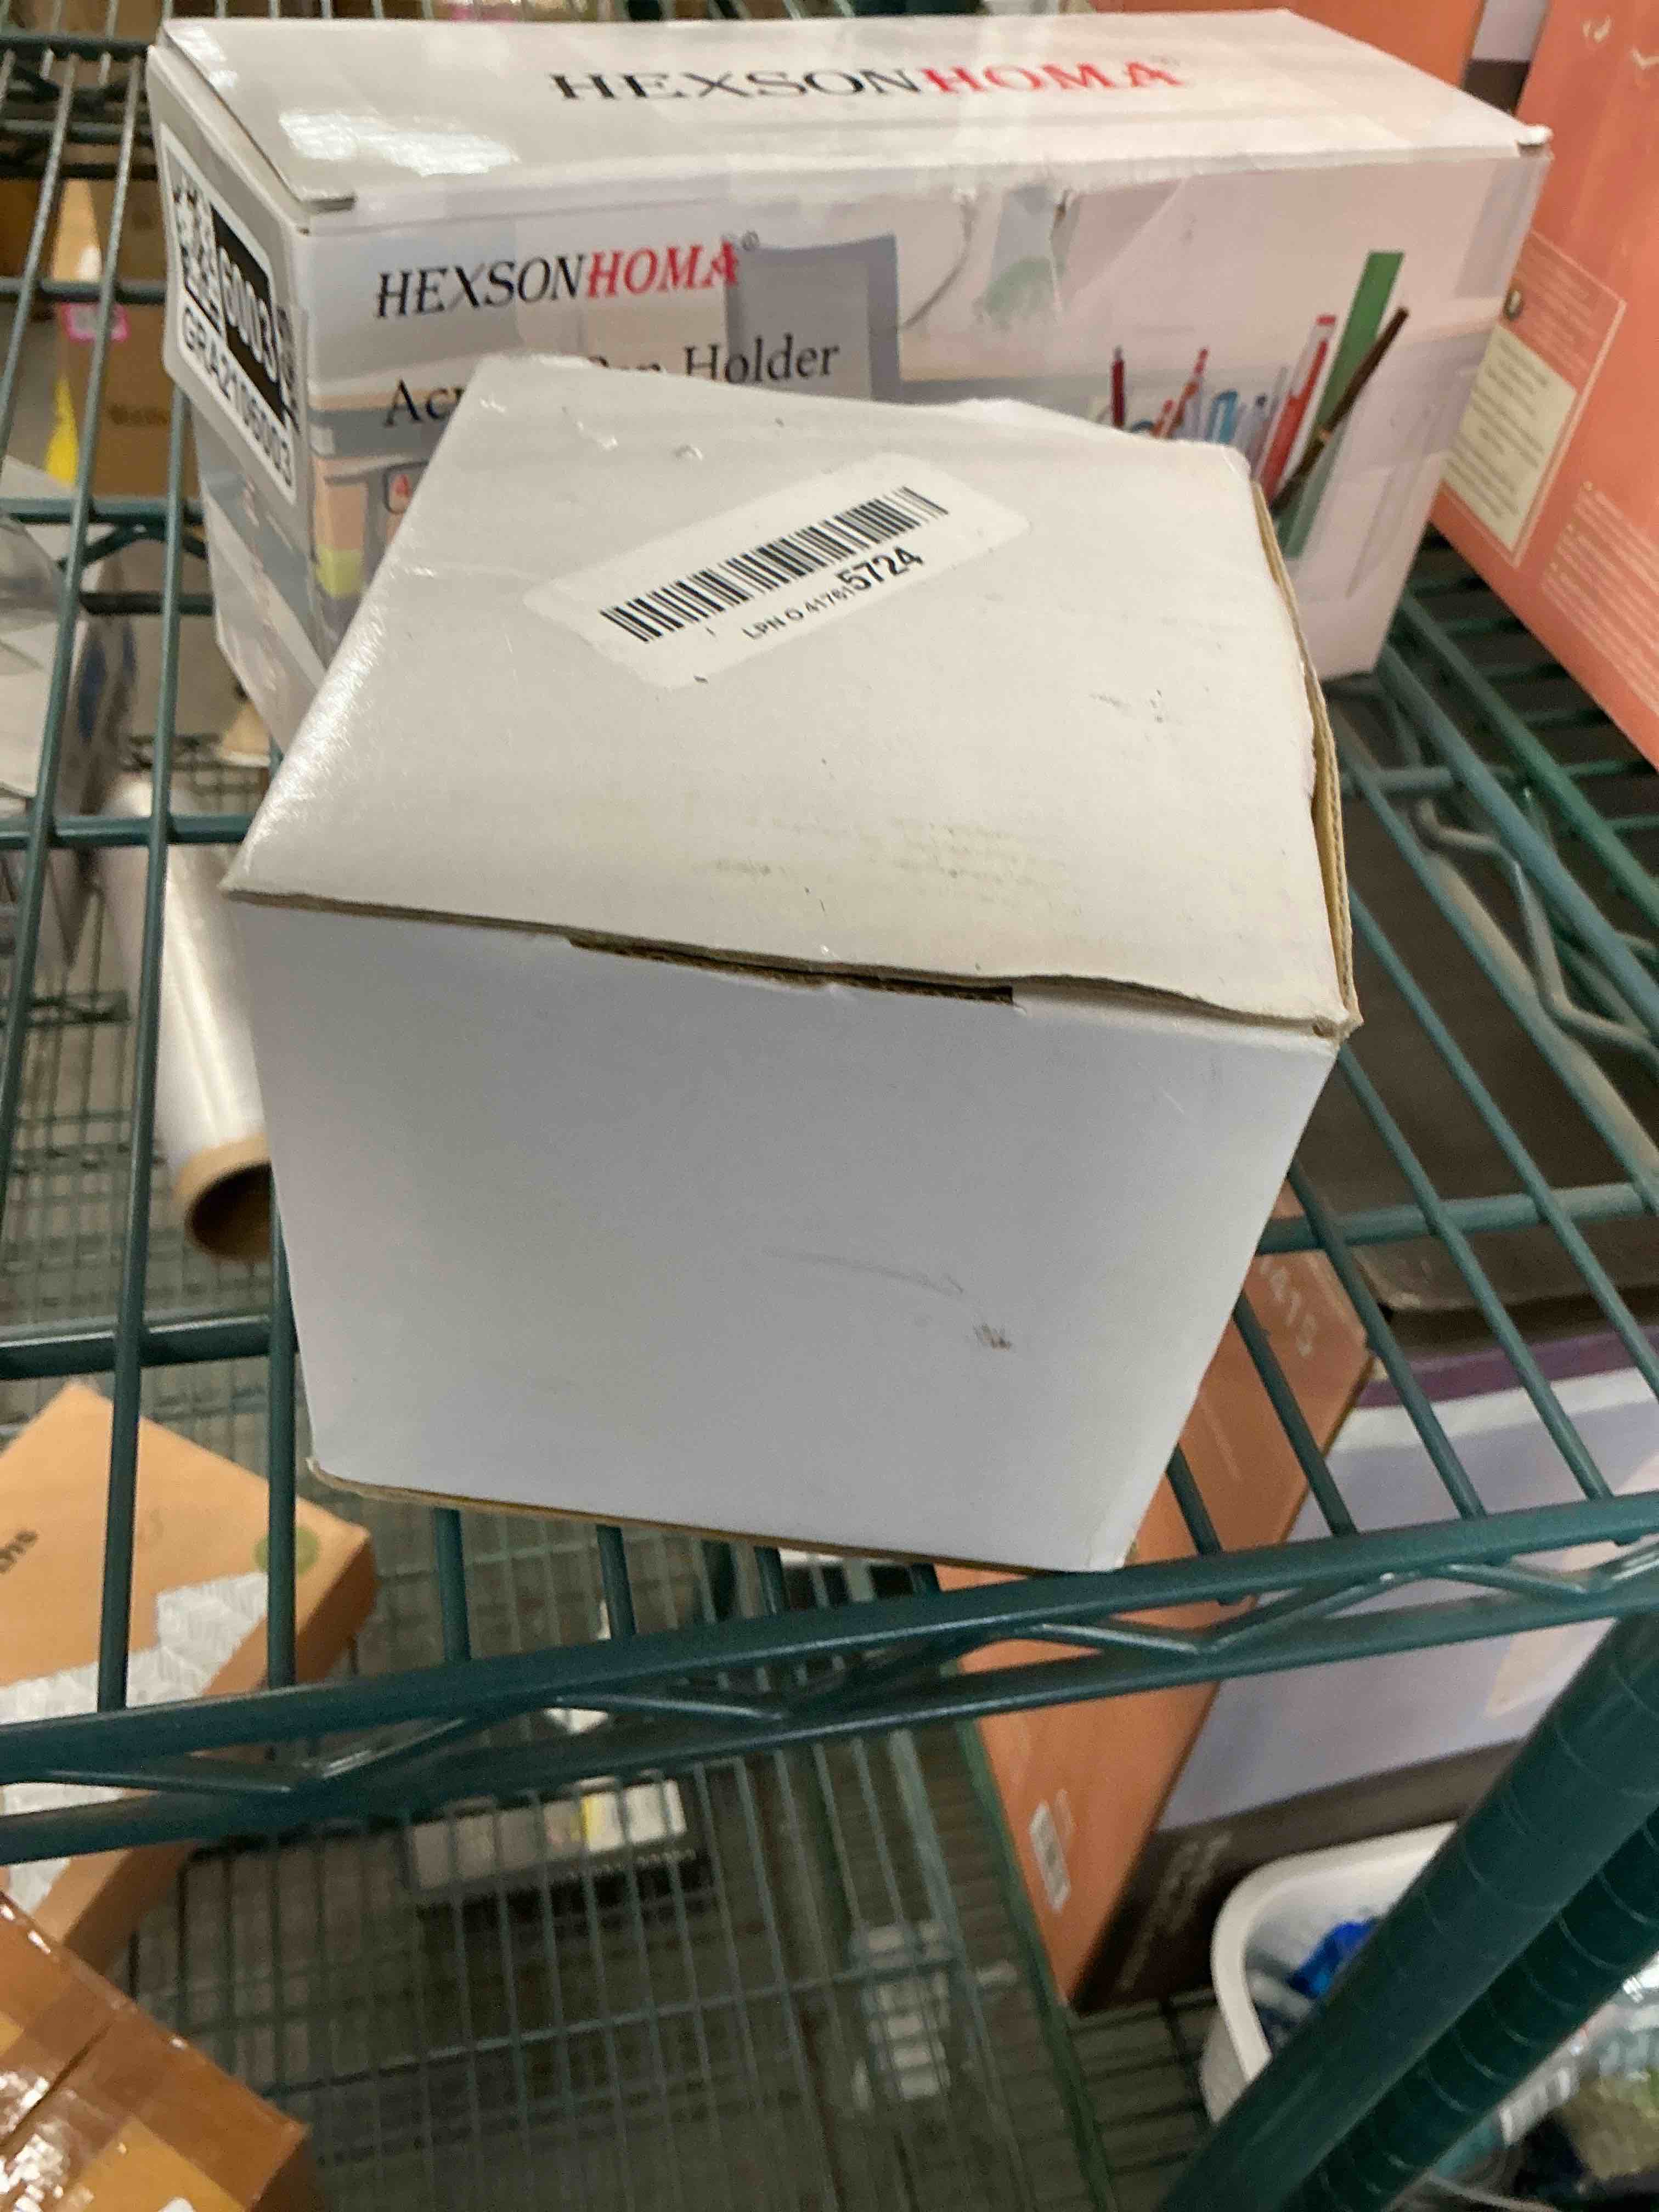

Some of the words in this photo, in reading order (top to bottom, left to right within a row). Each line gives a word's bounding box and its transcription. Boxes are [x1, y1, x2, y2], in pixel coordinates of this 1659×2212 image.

[546, 61, 1186, 100] HEXSONHOMA
[374, 240, 739, 319] HEXSONHOMA
[684, 332, 840, 383] Holder
